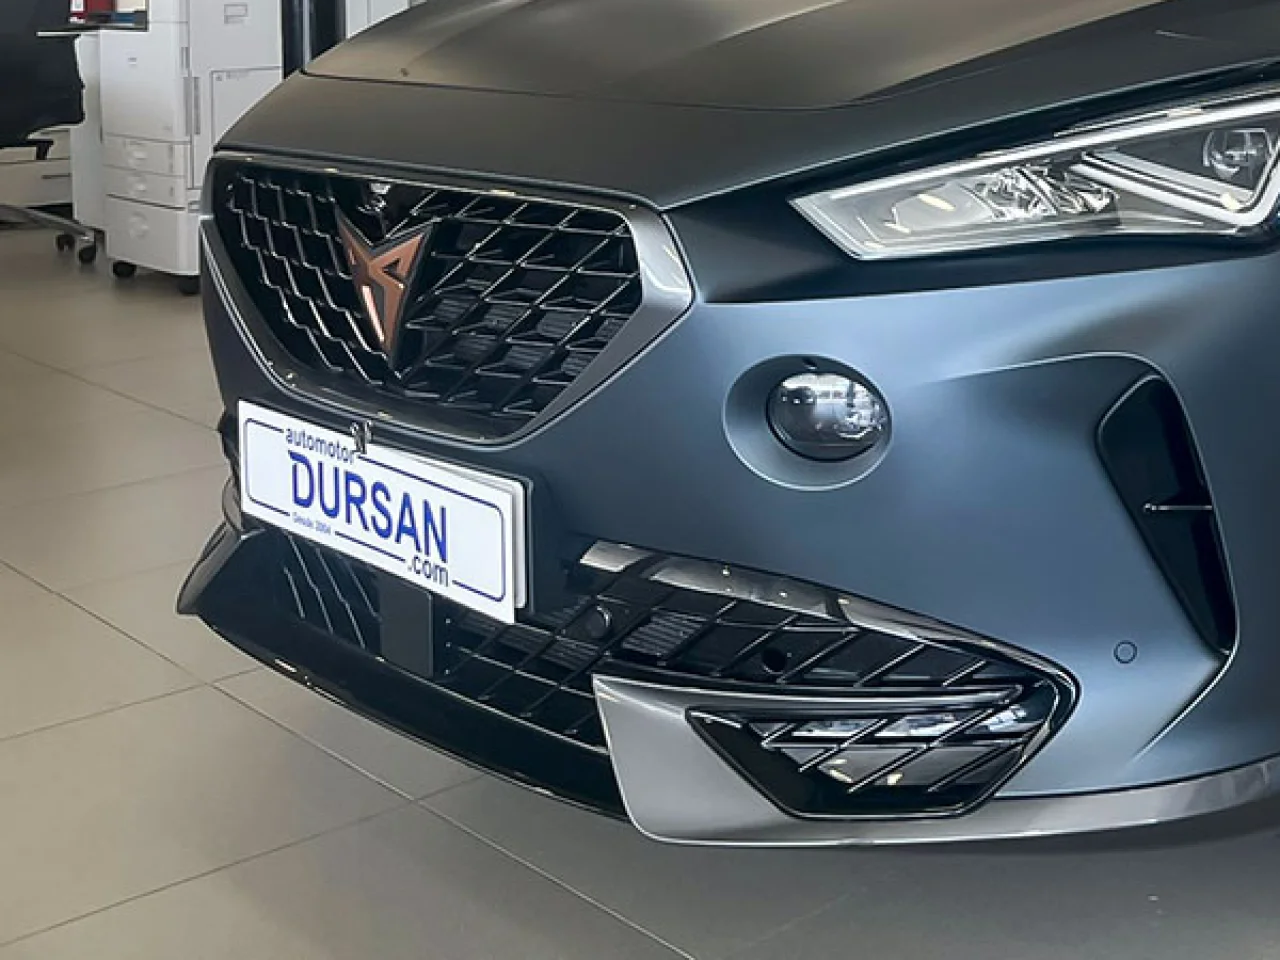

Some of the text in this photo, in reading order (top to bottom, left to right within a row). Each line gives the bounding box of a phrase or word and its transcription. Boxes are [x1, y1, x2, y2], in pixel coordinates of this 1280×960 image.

[285, 428, 356, 464] automotor
[288, 450, 448, 564] DURSAN
[407, 554, 449, 588] .com
